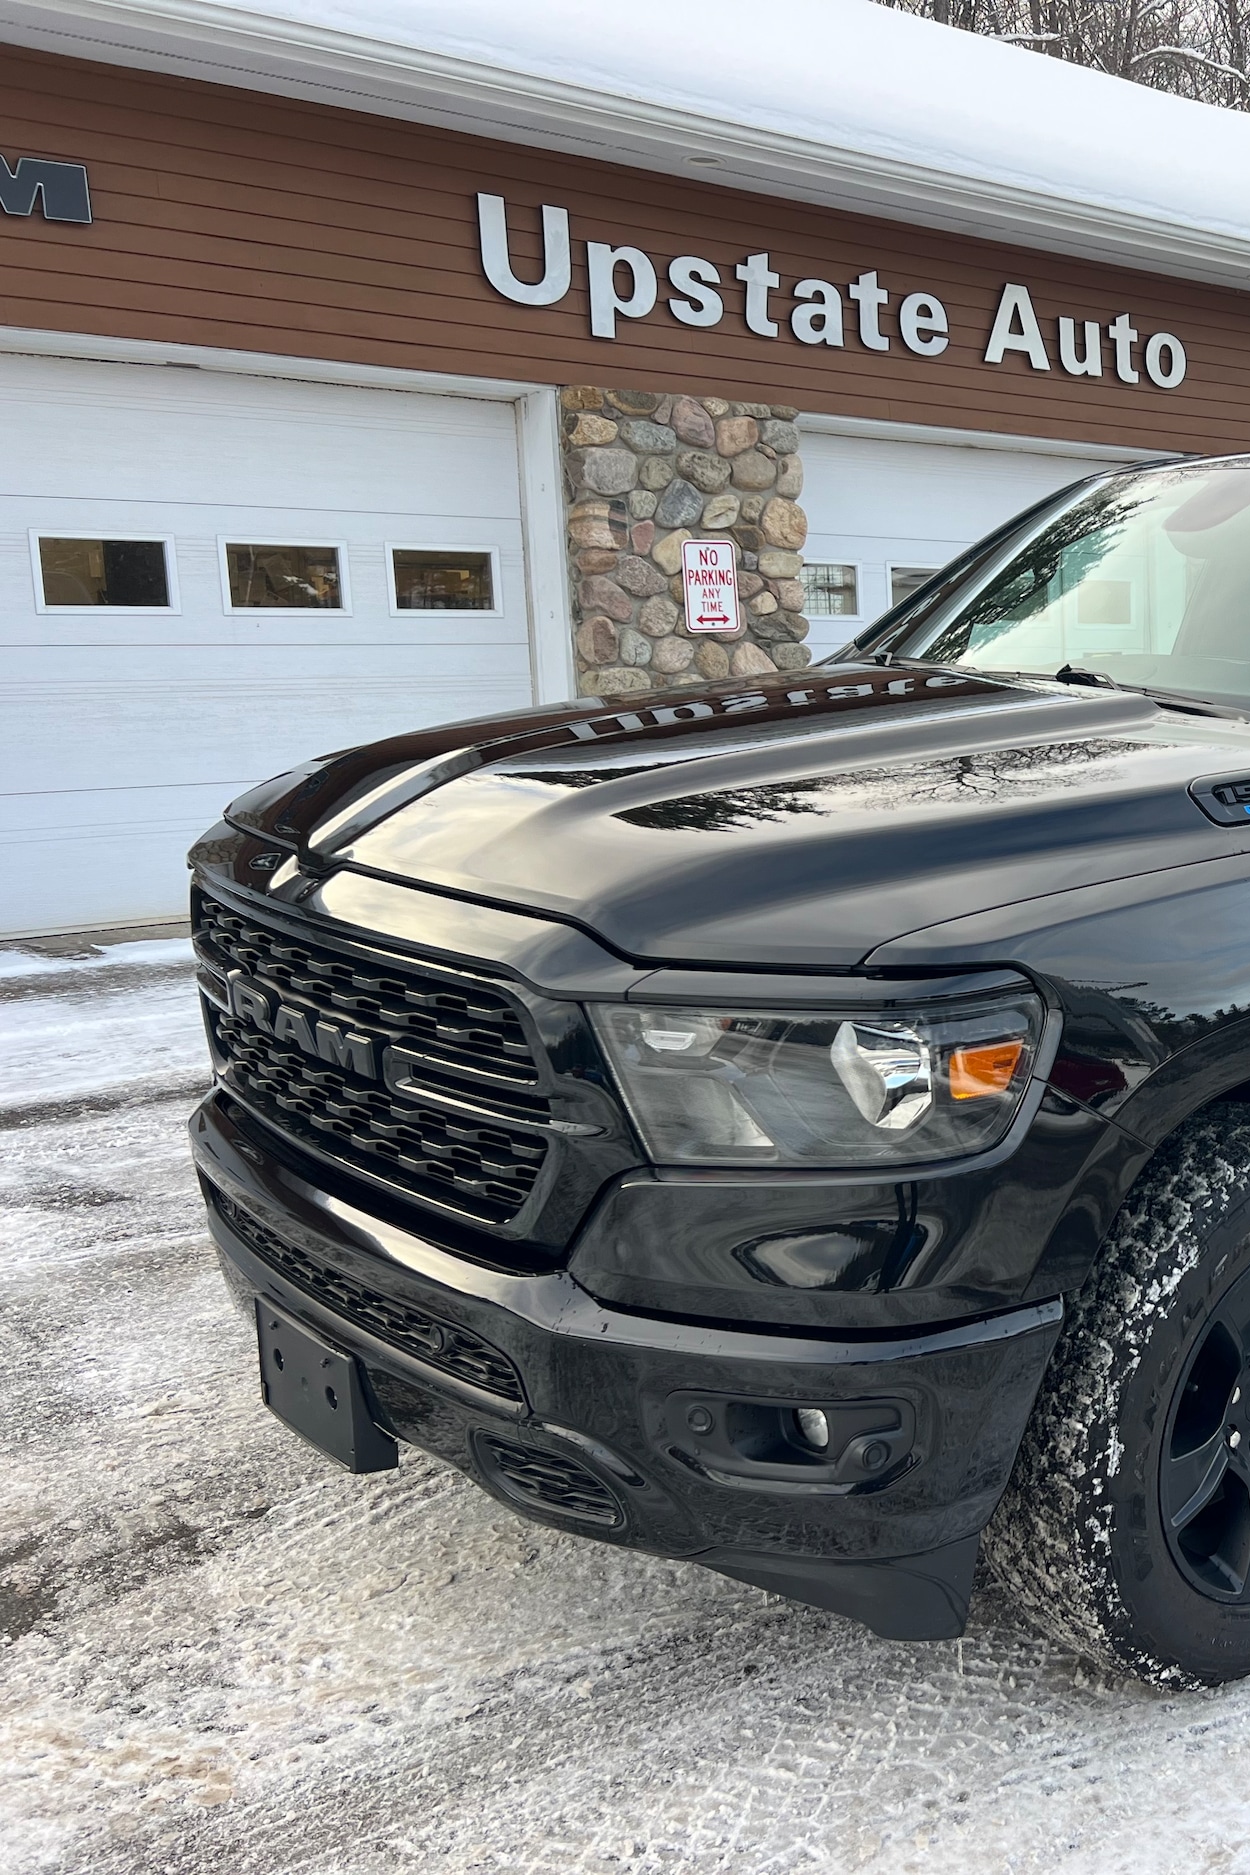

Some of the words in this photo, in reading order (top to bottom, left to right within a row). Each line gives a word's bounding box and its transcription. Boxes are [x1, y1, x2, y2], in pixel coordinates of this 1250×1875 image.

[476, 191, 950, 357] Upstate
[983, 282, 1188, 390] Auto
[699, 549, 718, 566] NO
[688, 569, 733, 586] PARKING
[702, 588, 721, 599] ANY
[701, 601, 724, 612] TIME
[232, 978, 384, 1080] RAM
